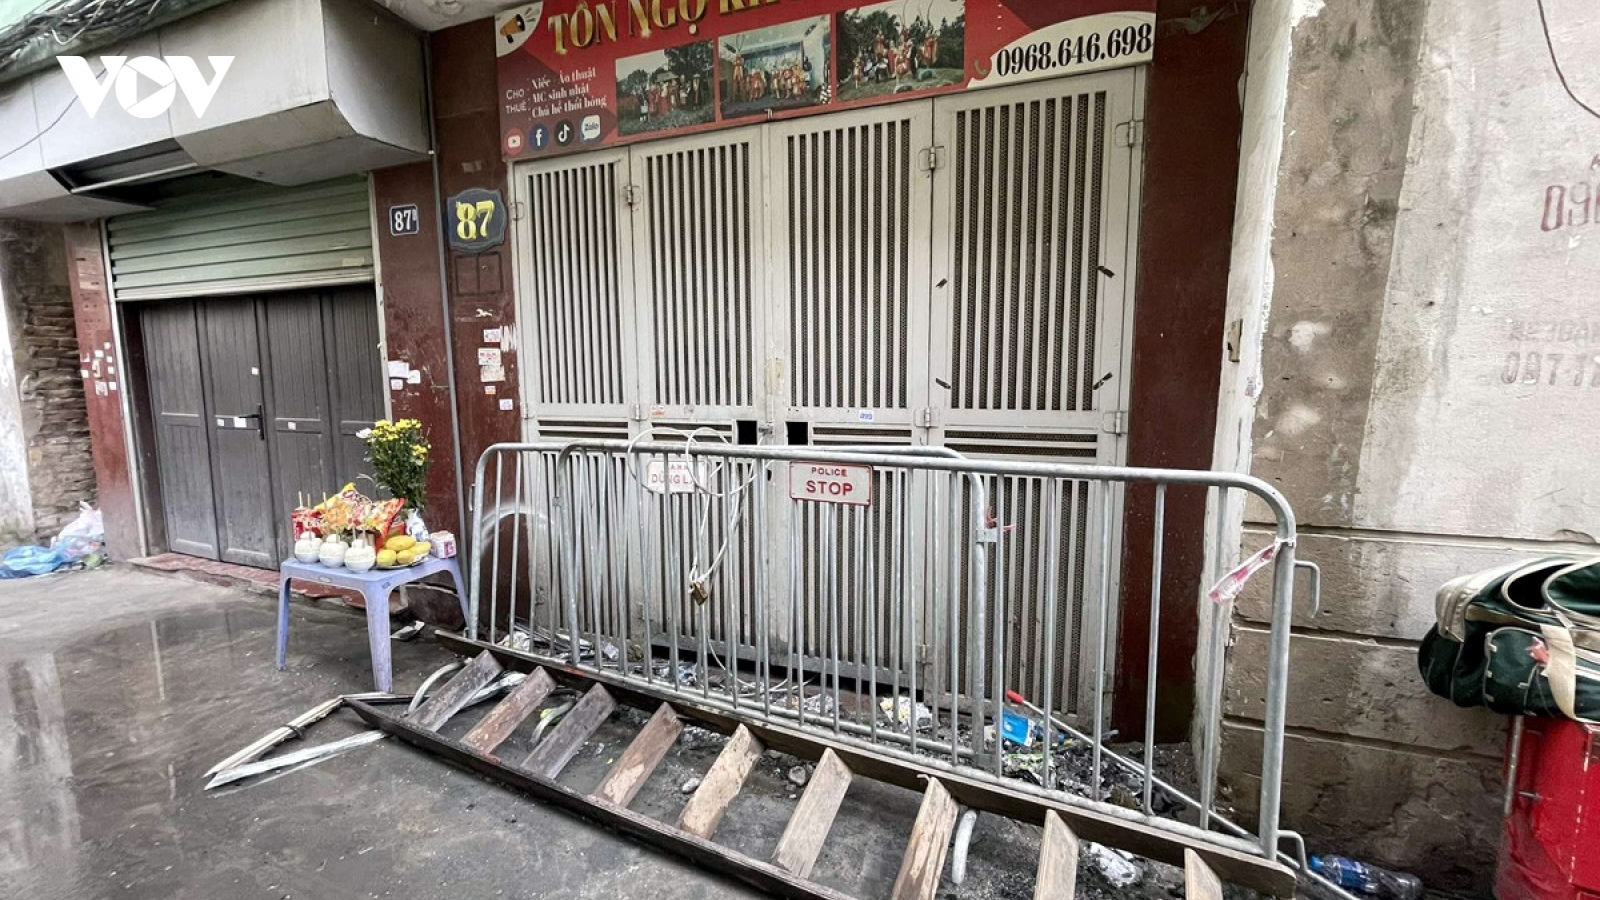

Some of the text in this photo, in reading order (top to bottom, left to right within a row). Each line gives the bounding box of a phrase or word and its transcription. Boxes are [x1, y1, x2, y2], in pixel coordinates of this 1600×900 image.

[548, 1, 617, 54] TÔN
[996, 23, 1153, 76] 0968.646.698
[506, 88, 525, 100] CHO
[455, 200, 495, 239] 87
[811, 466, 848, 477] POLICE
[806, 480, 853, 496] STOP
